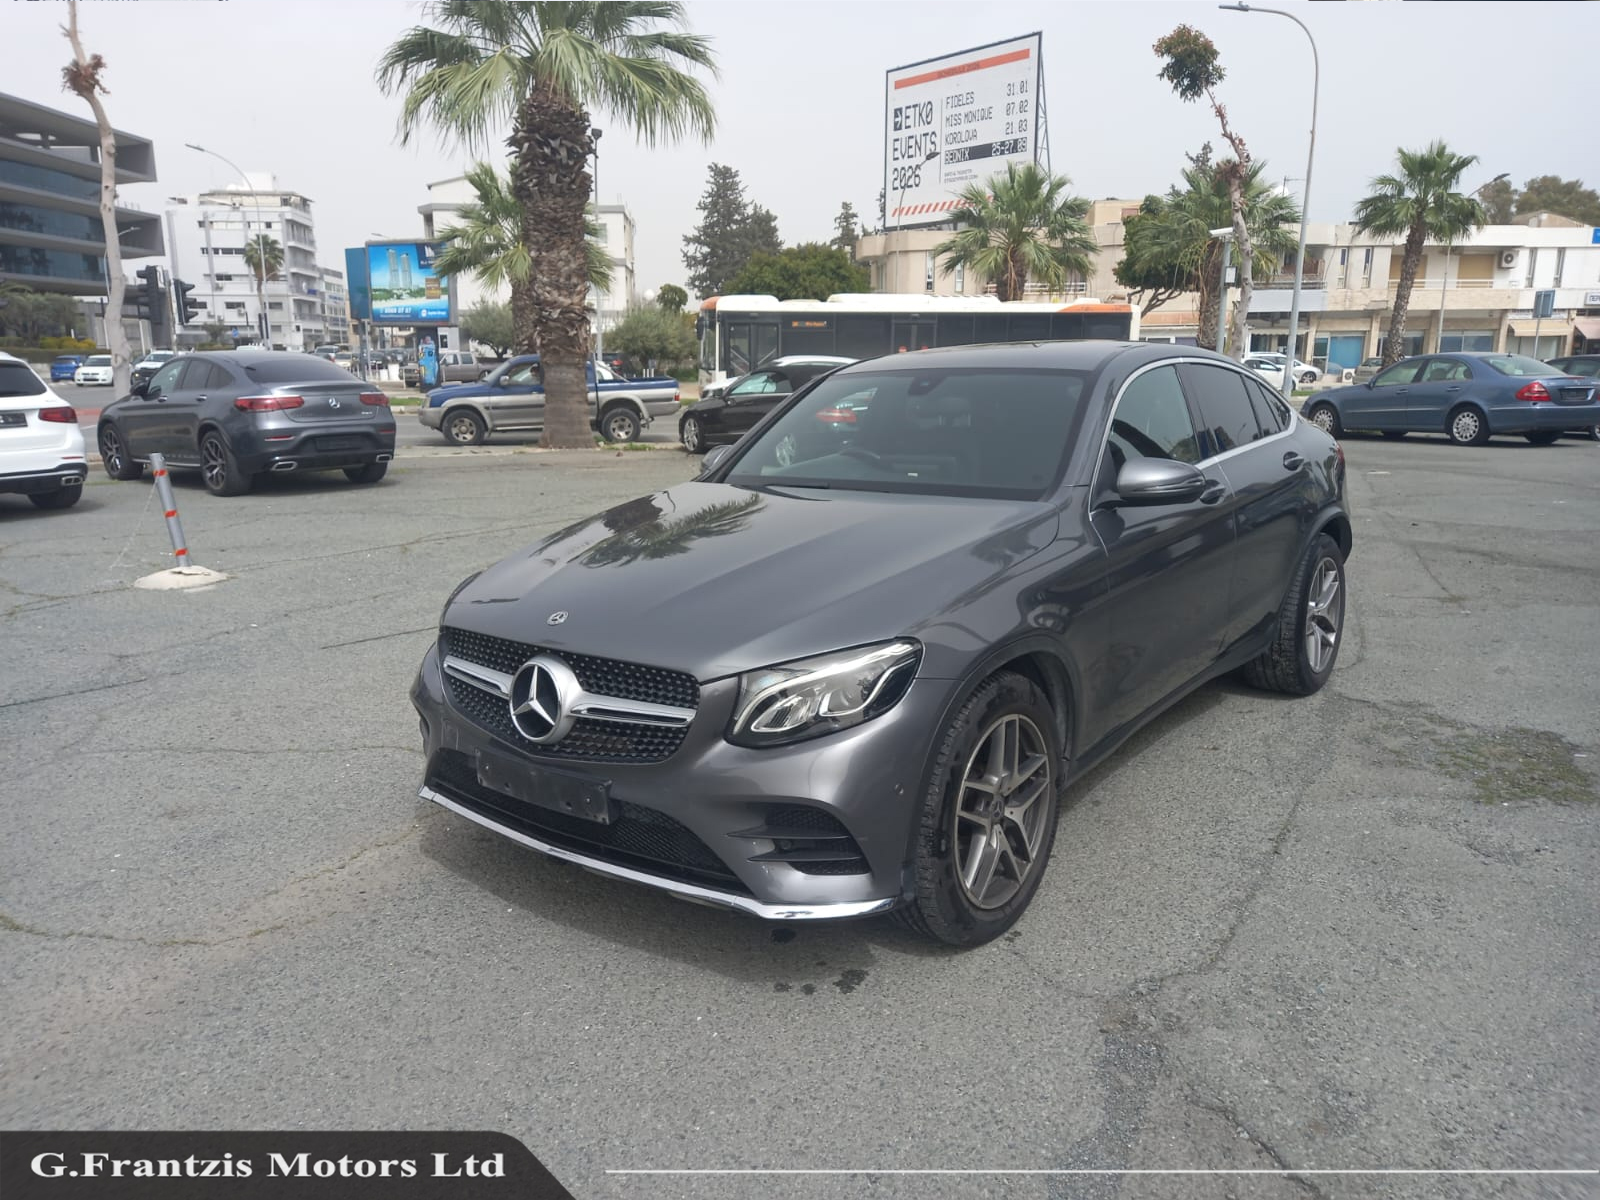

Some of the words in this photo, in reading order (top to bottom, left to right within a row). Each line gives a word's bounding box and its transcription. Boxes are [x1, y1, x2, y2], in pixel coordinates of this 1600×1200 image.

[945, 91, 975, 109] FIDELES
[1006, 80, 1029, 97] 31.01
[945, 112, 962, 128] MISS
[963, 106, 993, 124] MONIQUE
[1005, 99, 1029, 116] 07.02
[1005, 118, 1028, 135] 21.03
[893, 131, 937, 161] EVENTS
[944, 147, 970, 164] BEONIX
[892, 164, 921, 191] 2026
